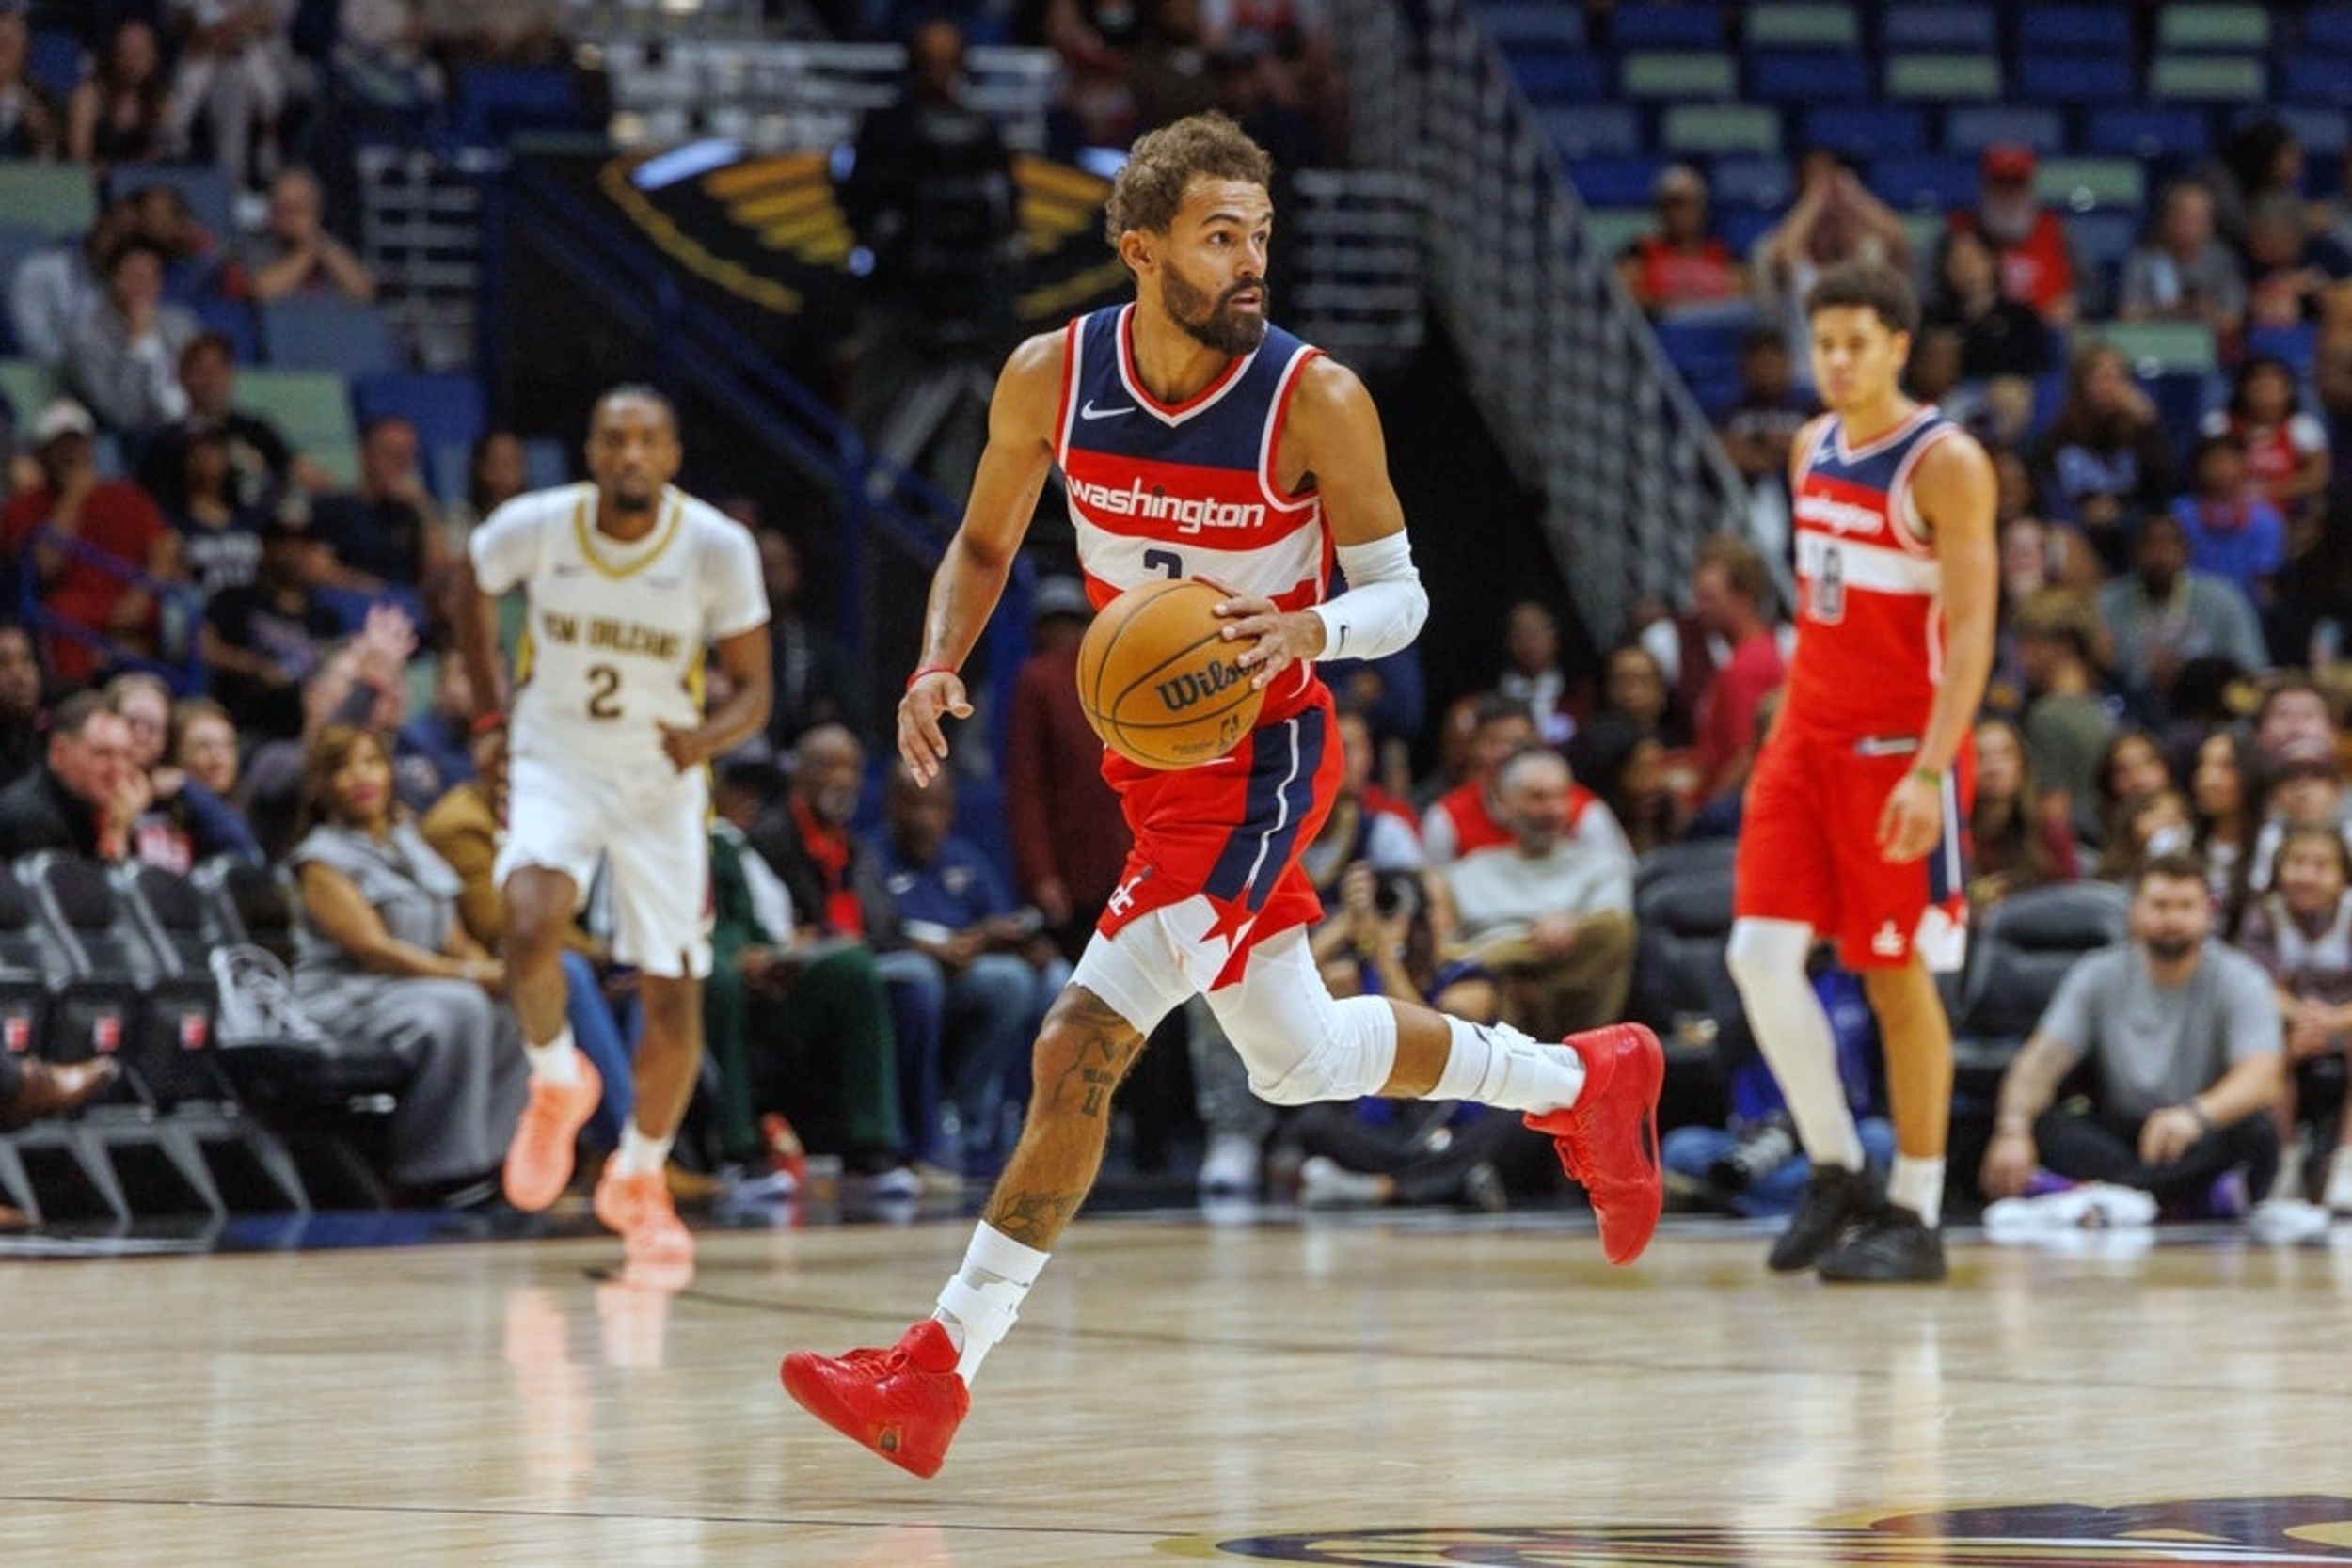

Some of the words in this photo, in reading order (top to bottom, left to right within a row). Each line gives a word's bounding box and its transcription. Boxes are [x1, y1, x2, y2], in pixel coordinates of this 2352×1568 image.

[1067, 476, 1266, 534] washington
[585, 663, 621, 720] 2
[1154, 659, 1257, 711] Wils
